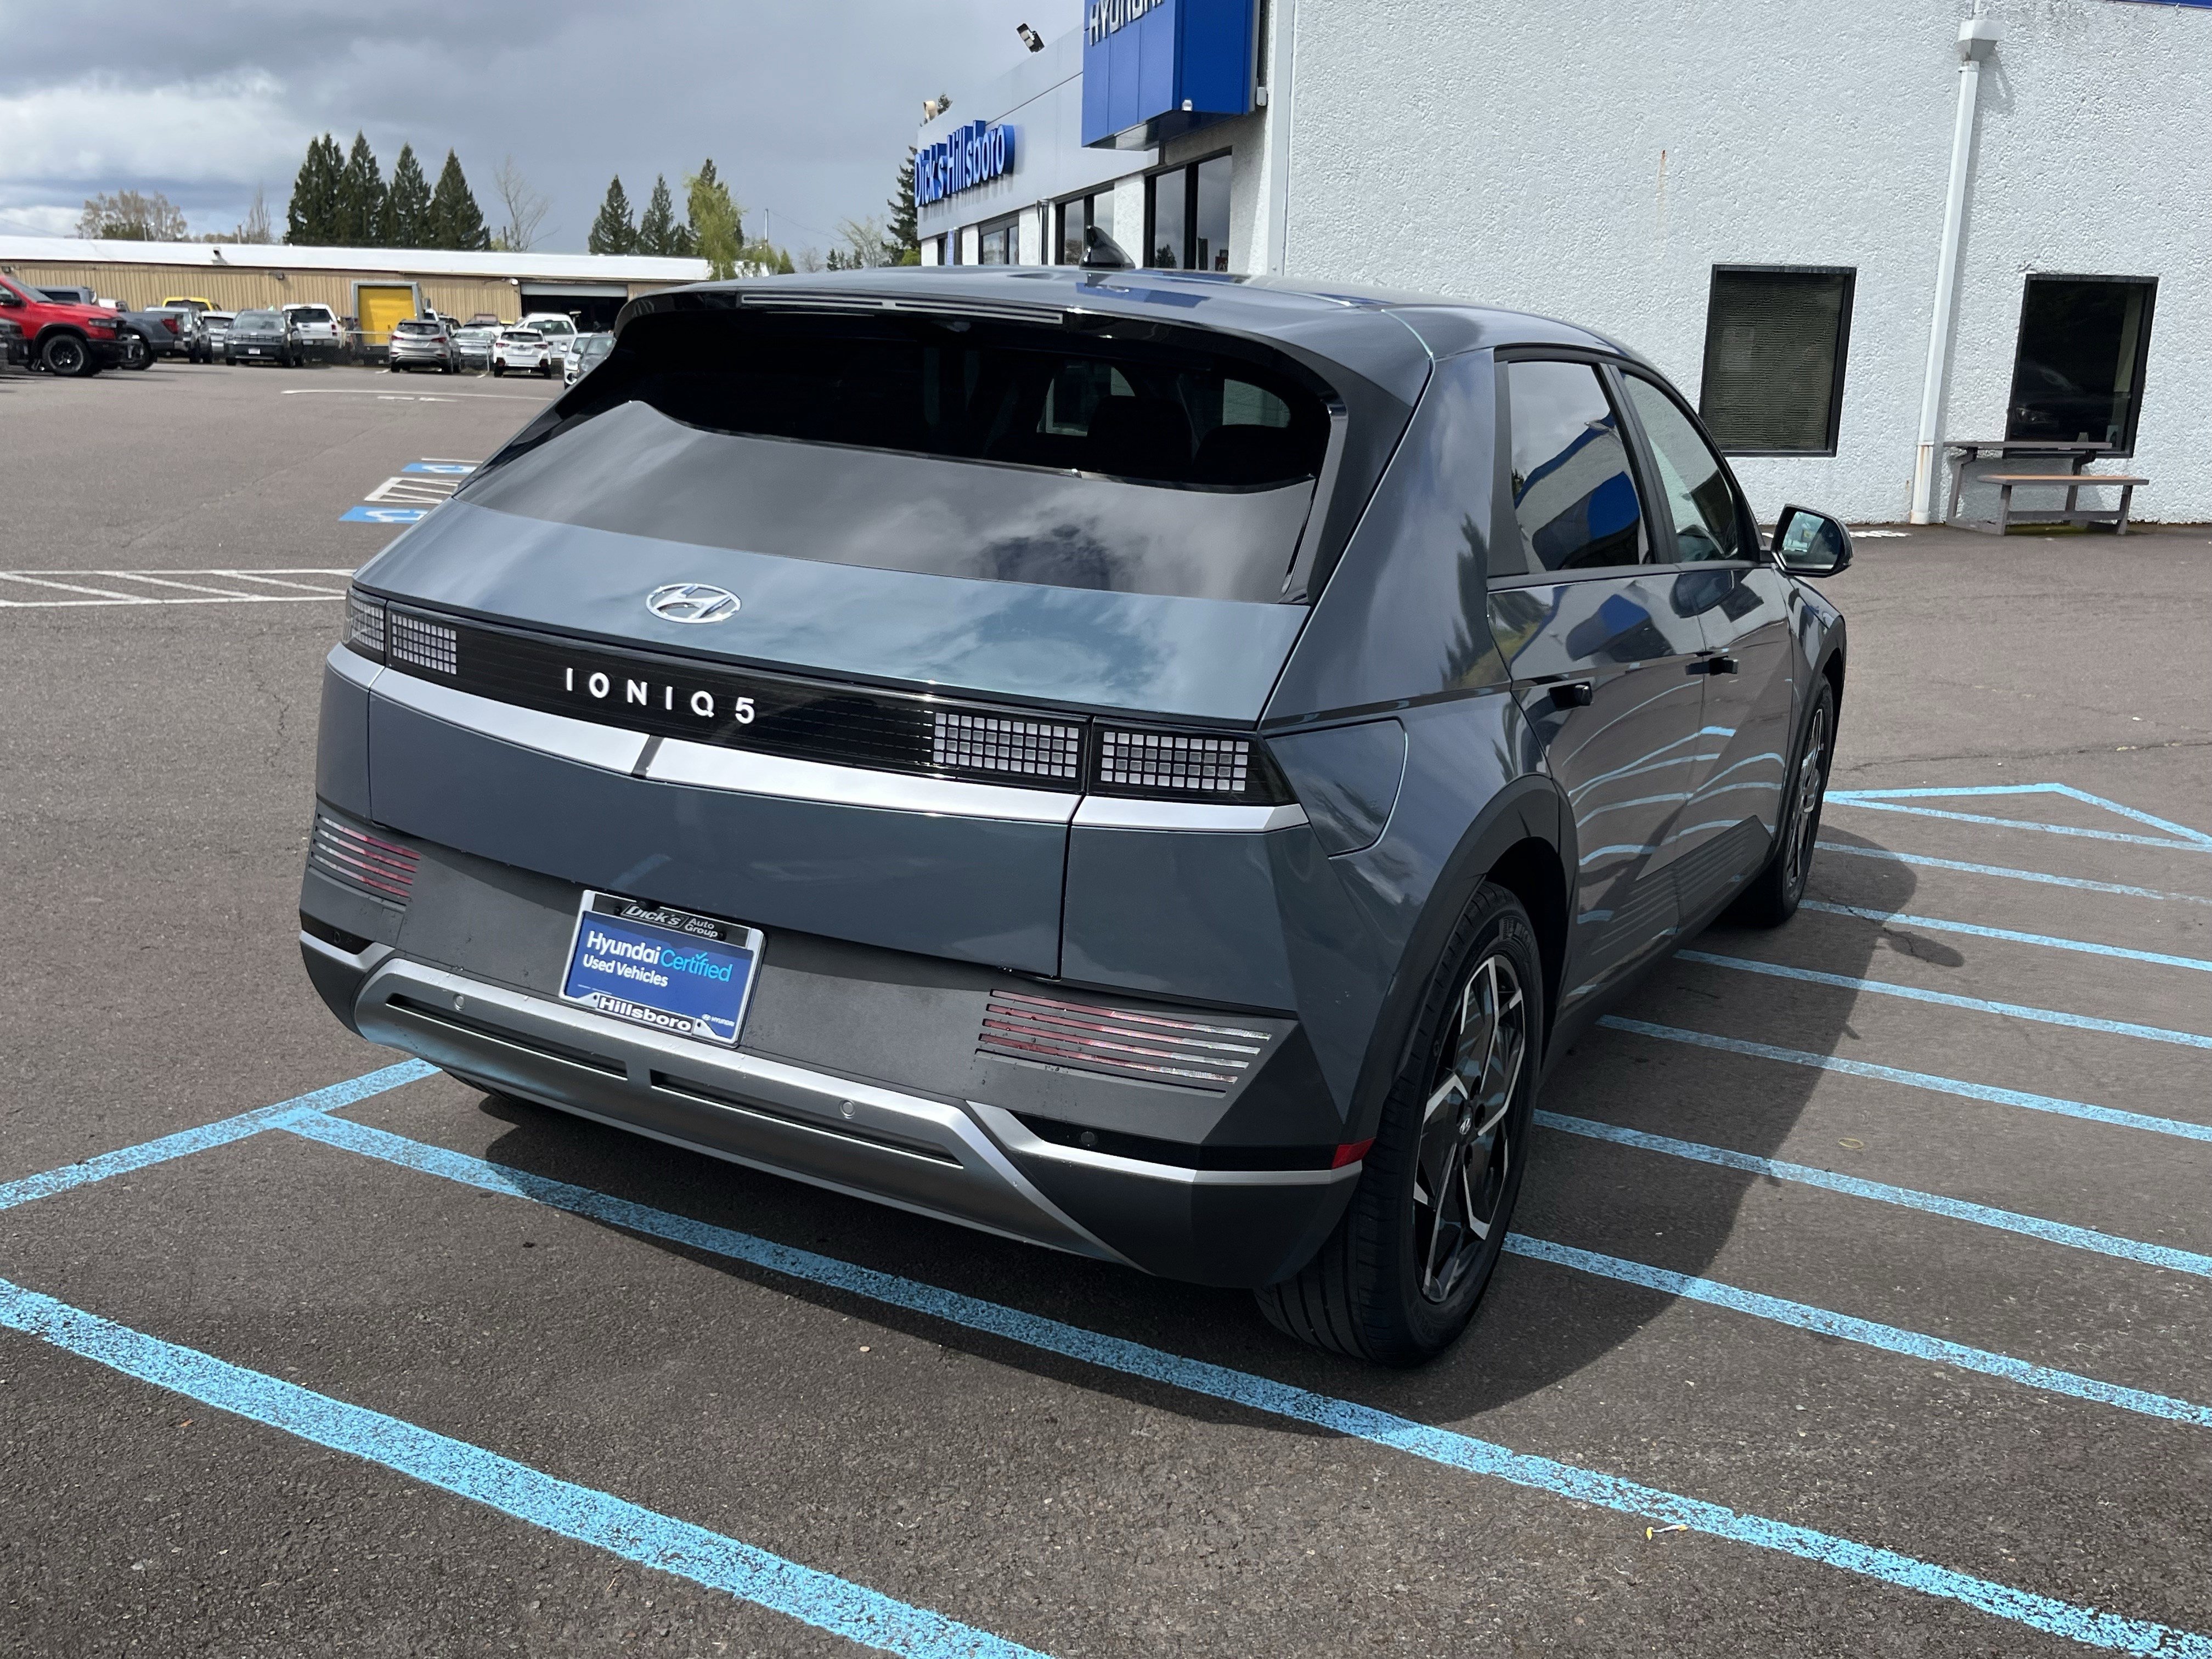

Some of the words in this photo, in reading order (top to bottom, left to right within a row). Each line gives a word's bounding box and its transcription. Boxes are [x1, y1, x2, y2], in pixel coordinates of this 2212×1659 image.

[915, 143, 946, 207] Dick's
[947, 120, 1008, 195] Hillsboro
[566, 667, 714, 718] IONIQ
[735, 697, 755, 724] 5
[684, 923, 719, 938] Group
[689, 918, 715, 930] Auto
[583, 953, 616, 973] Used
[616, 962, 669, 987] Vehicles
[586, 930, 662, 964] Hyundai
[660, 949, 733, 982] Certified
[599, 997, 691, 1031] Hillsboro
